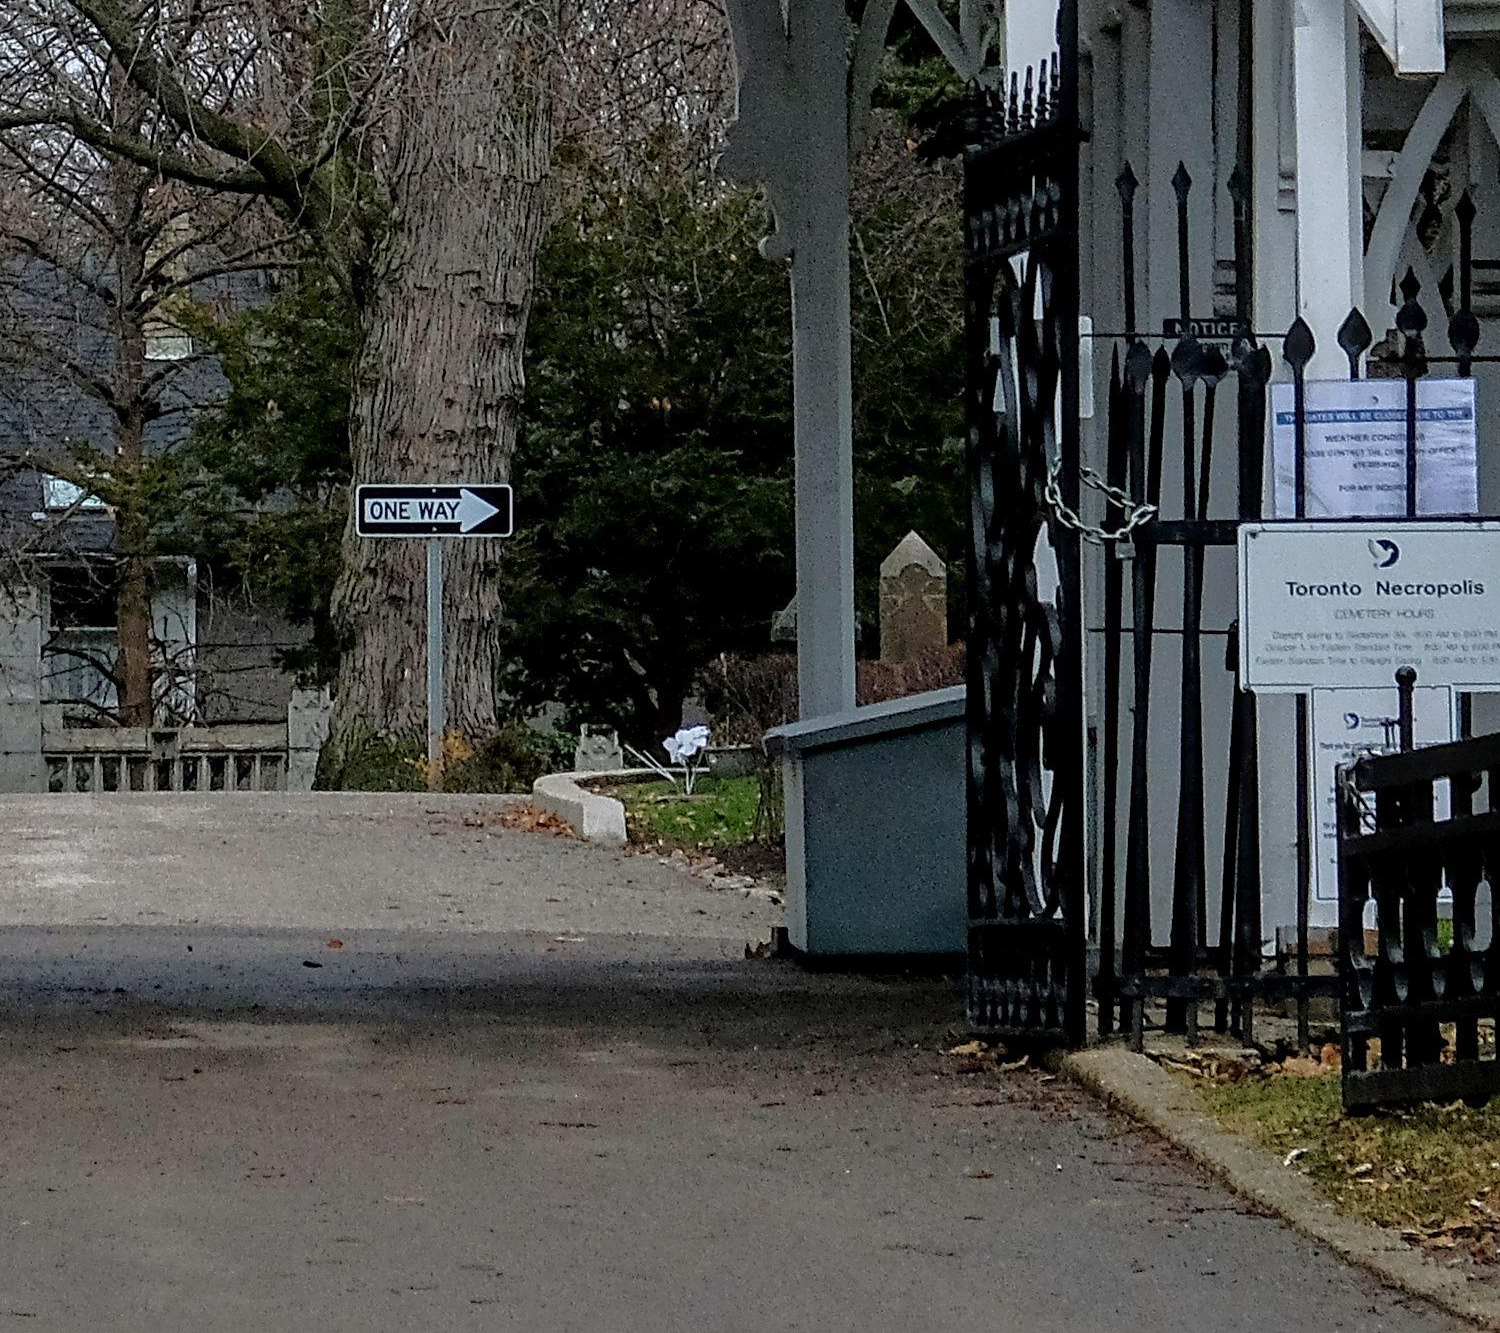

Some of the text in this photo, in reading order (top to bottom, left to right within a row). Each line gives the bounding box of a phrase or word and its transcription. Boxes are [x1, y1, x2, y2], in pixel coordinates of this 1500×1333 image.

[370, 501, 460, 520] ONE WAY
[1285, 579, 1485, 598] Toronto Necropolis
[1334, 608, 1434, 620] CEMETERY HOURS
